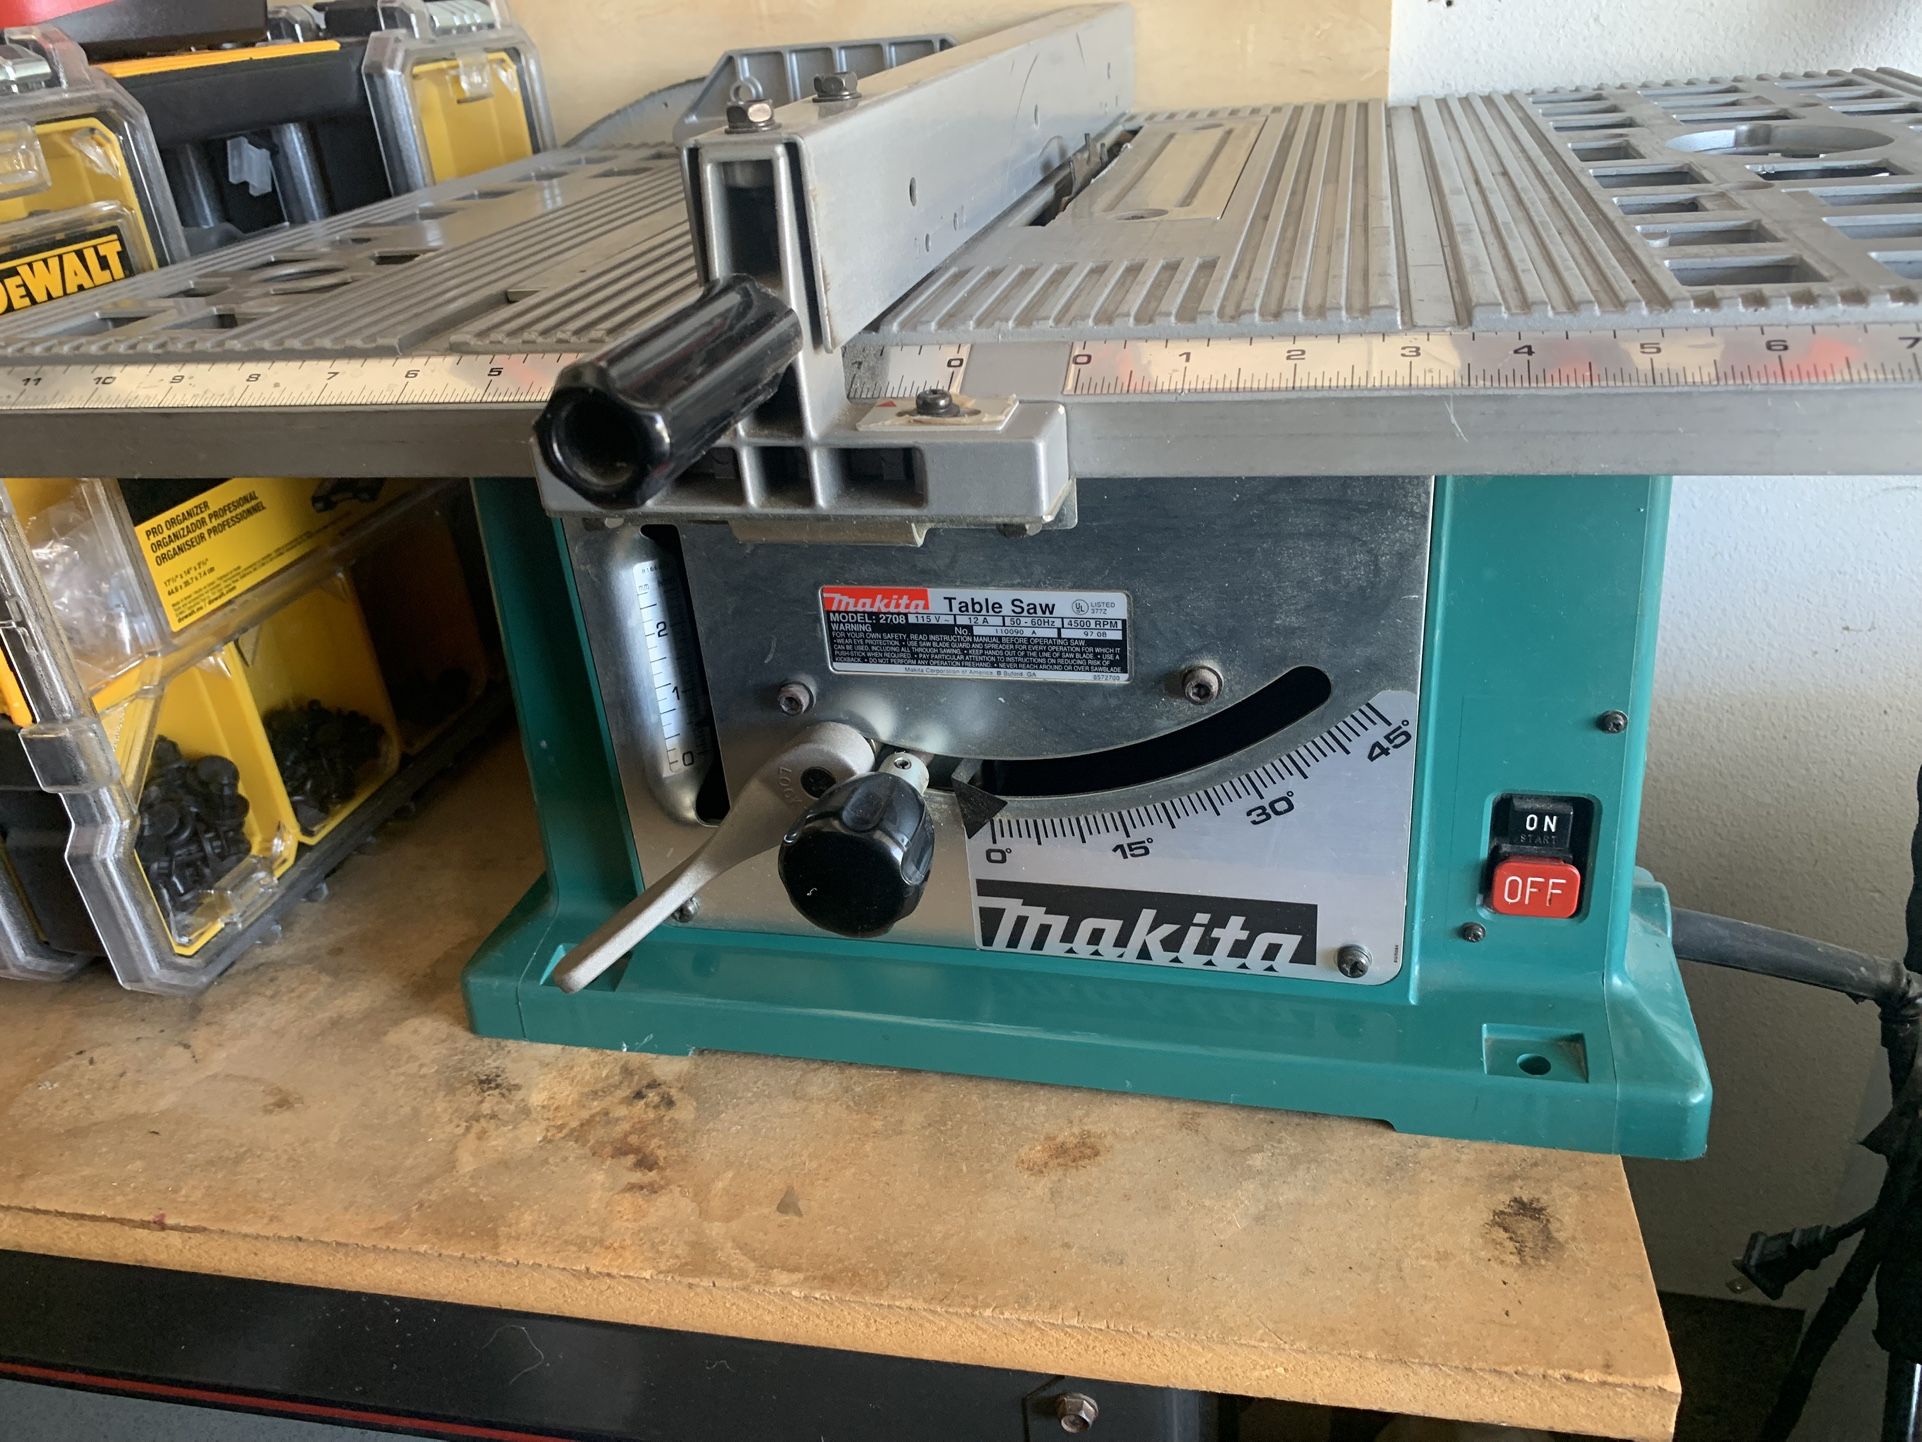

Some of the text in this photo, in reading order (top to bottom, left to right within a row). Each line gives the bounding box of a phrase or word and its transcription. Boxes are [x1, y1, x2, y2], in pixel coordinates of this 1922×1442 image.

[1072, 337, 1922, 365] 0 1 2 3 4 5 6 7
[946, 357, 964, 368] 0
[21, 367, 503, 386] 11 10 9 8 7 6 5
[145, 500, 210, 540] PRO ORGANIZER
[150, 490, 259, 554] ORGANIZADOR PROFESIONAL
[155, 500, 267, 567] ORGANISEUR PROFESSIONNEL
[944, 597, 1002, 614] Table
[1011, 598, 1056, 616] Saw
[656, 621, 668, 638] 2
[830, 612, 876, 624] MODEL:
[880, 614, 906, 624] 2708
[915, 616, 931, 624] 115
[1010, 618, 1022, 626] 50
[1030, 619, 1056, 627] 60Hz
[1067, 620, 1092, 628] 4500
[1094, 620, 1118, 628] RPM
[830, 622, 872, 632] WARNING
[954, 627, 971, 636] No.
[672, 686, 680, 700] 1
[1366, 719, 1410, 763] 45°
[682, 752, 694, 766] 0
[1246, 790, 1295, 826] 30°
[1525, 814, 1558, 832] ON
[1111, 837, 1154, 860] 15°
[1520, 834, 1558, 844] START
[986, 848, 1013, 864] 0°
[1504, 876, 1566, 907] OFF
